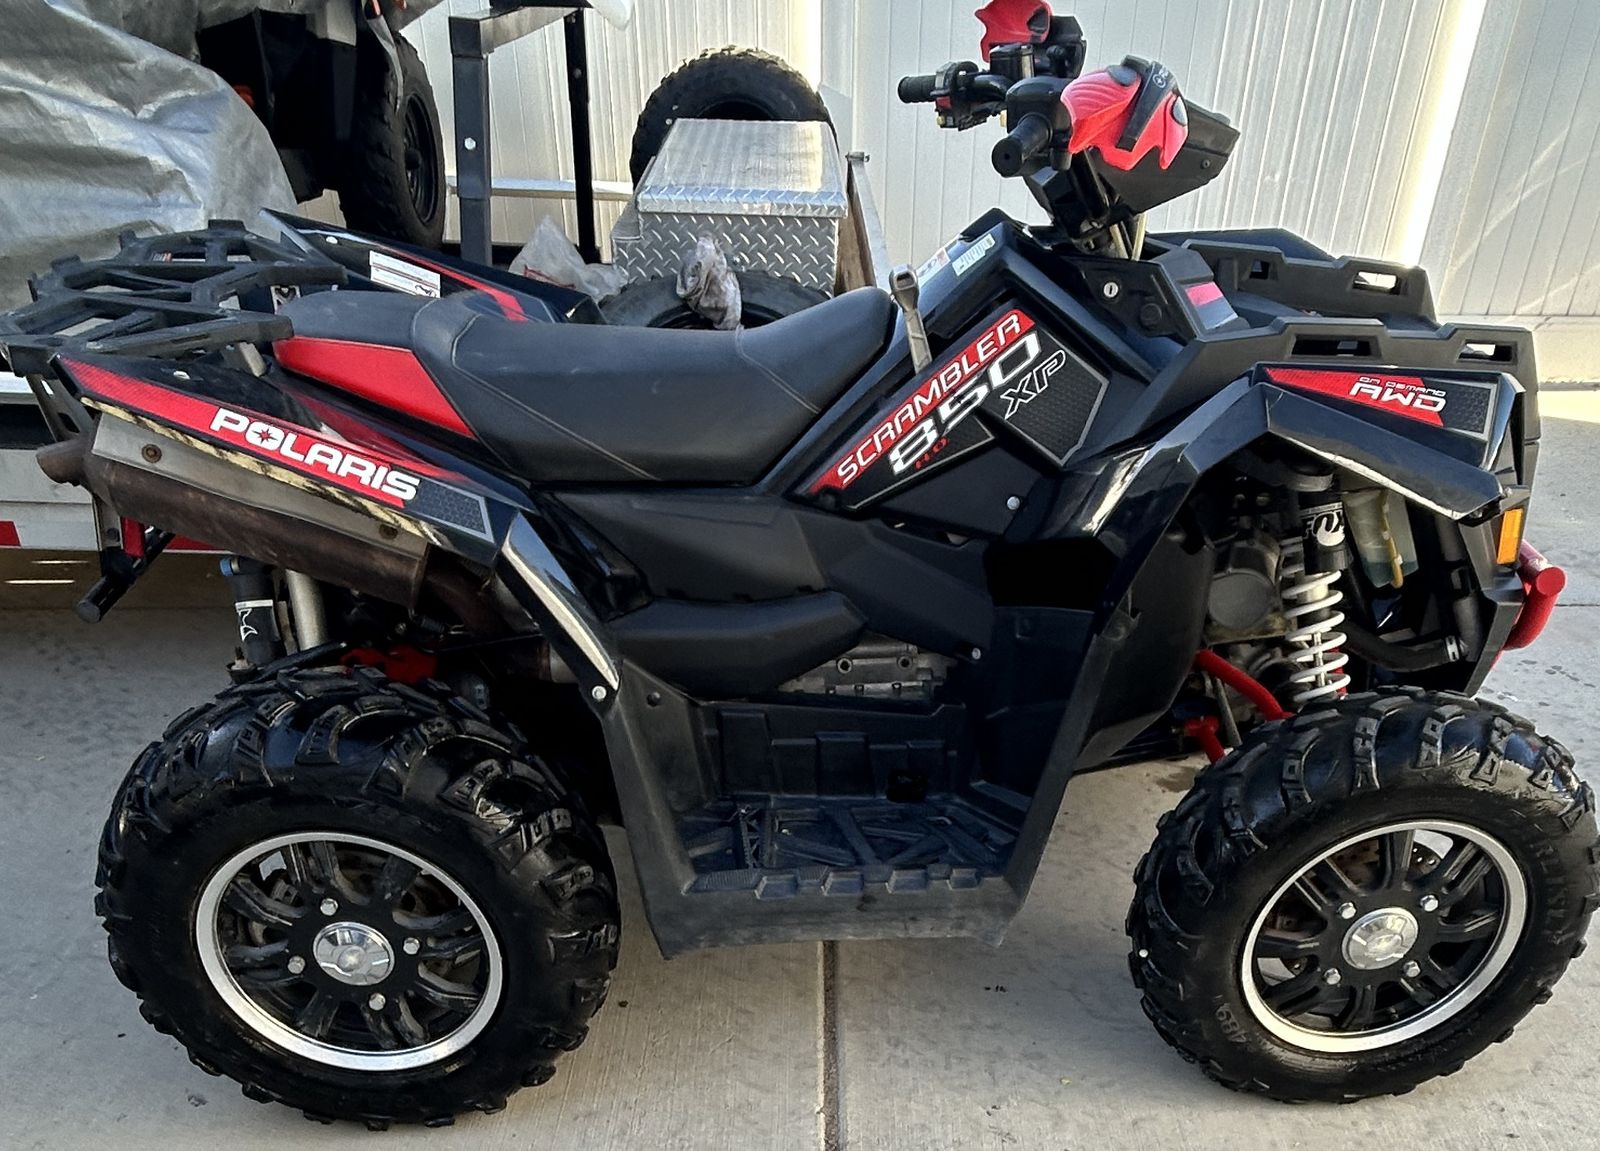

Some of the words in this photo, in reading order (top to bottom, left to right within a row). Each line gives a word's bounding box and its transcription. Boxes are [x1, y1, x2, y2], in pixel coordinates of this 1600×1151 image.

[837, 313, 1021, 485] SCRAMBLER
[889, 331, 1042, 475] 850
[1000, 350, 1066, 420] XP
[1349, 382, 1446, 412] AWD
[209, 407, 420, 500] POLARIS
